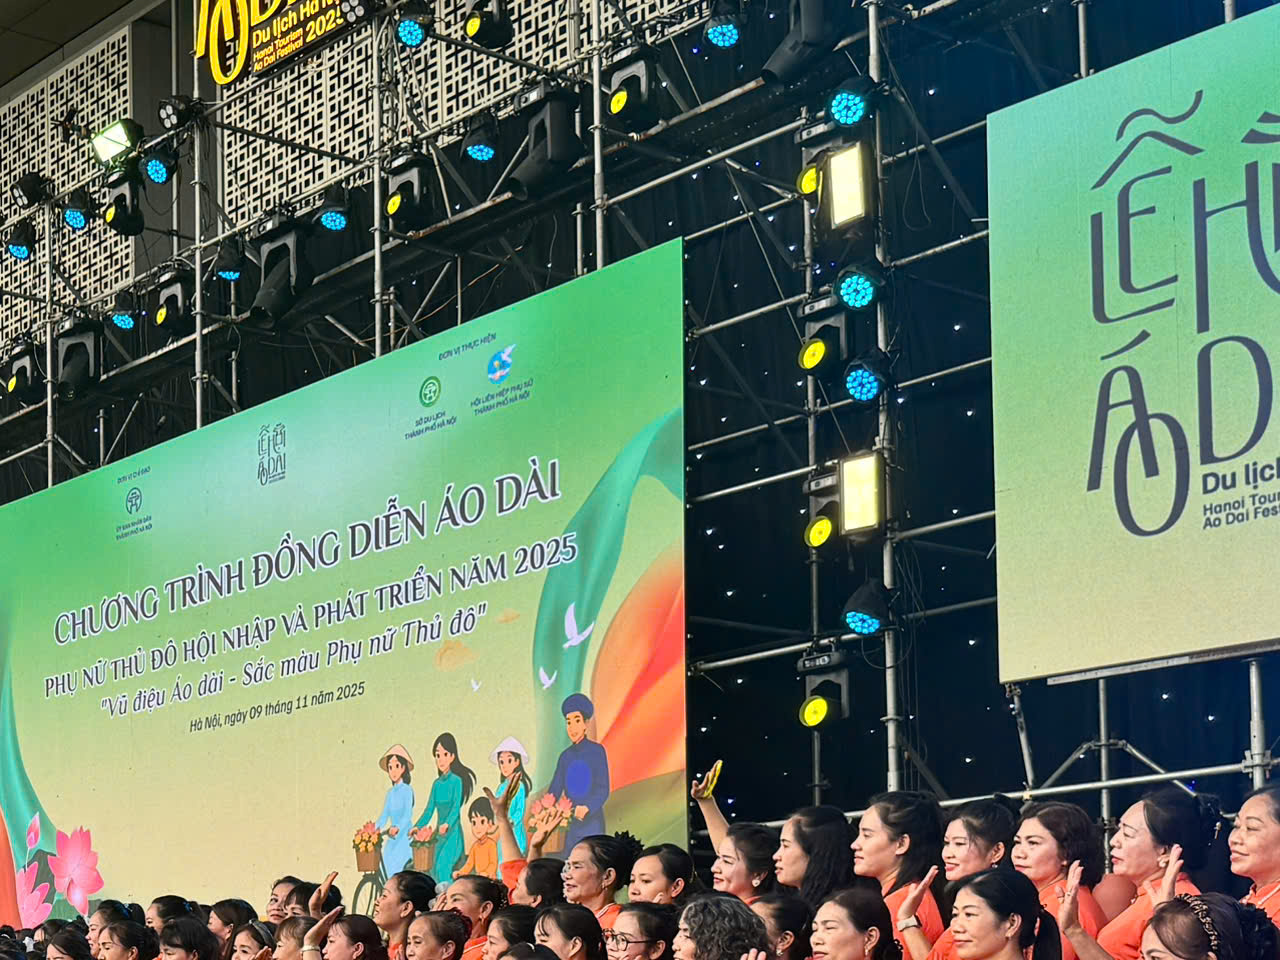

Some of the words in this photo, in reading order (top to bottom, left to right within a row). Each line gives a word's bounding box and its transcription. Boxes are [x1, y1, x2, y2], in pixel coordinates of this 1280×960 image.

[252, 26, 271, 49] Du
[273, 11, 297, 38] lịch
[253, 45, 274, 63] Hanoi
[274, 29, 303, 50] Tourism
[253, 61, 263, 73] Ao
[263, 53, 276, 68] Dai
[276, 37, 304, 59] Festival
[1087, 328, 1191, 537] ÁO
[1202, 471, 1236, 495] Du
[1203, 496, 1245, 517] Hanoi
[1203, 516, 1222, 530] Ao
[1225, 508, 1249, 525] Dai
[1253, 504, 1280, 520] Fes
[54, 587, 159, 644] CHƯƠNG
[165, 559, 245, 611] TRÌNH
[253, 531, 340, 587] ĐỒNG
[349, 496, 426, 558] DIỄN
[436, 484, 485, 533] ÁO
[496, 458, 560, 514] DÀI
[45, 671, 78, 697] PHỤ
[83, 659, 107, 687] NỮ
[111, 648, 145, 680] THỦ
[151, 640, 177, 670] ĐÔ
[183, 631, 216, 663] HỘI
[222, 617, 275, 650] NHẬP
[282, 605, 308, 636] VÀ
[314, 590, 368, 628] PHÁT
[374, 565, 442, 611] TRIỂN
[450, 554, 507, 591] NĂM
[514, 533, 577, 575] 2025
[133, 687, 165, 712] điệu
[170, 676, 192, 702] Áo
[198, 671, 224, 697] dài
[242, 657, 275, 686] Sắc
[281, 650, 320, 676] màu
[327, 640, 362, 666] Phụ
[369, 626, 397, 655] nữ
[402, 613, 442, 647] Thủ
[190, 719, 203, 733] Hà
[204, 713, 222, 731] Nội,
[224, 709, 248, 727] ngày
[249, 705, 263, 719] 09
[265, 700, 293, 716] tháng
[295, 695, 308, 709] 11
[311, 691, 334, 706] năm
[336, 681, 365, 701] 2025
